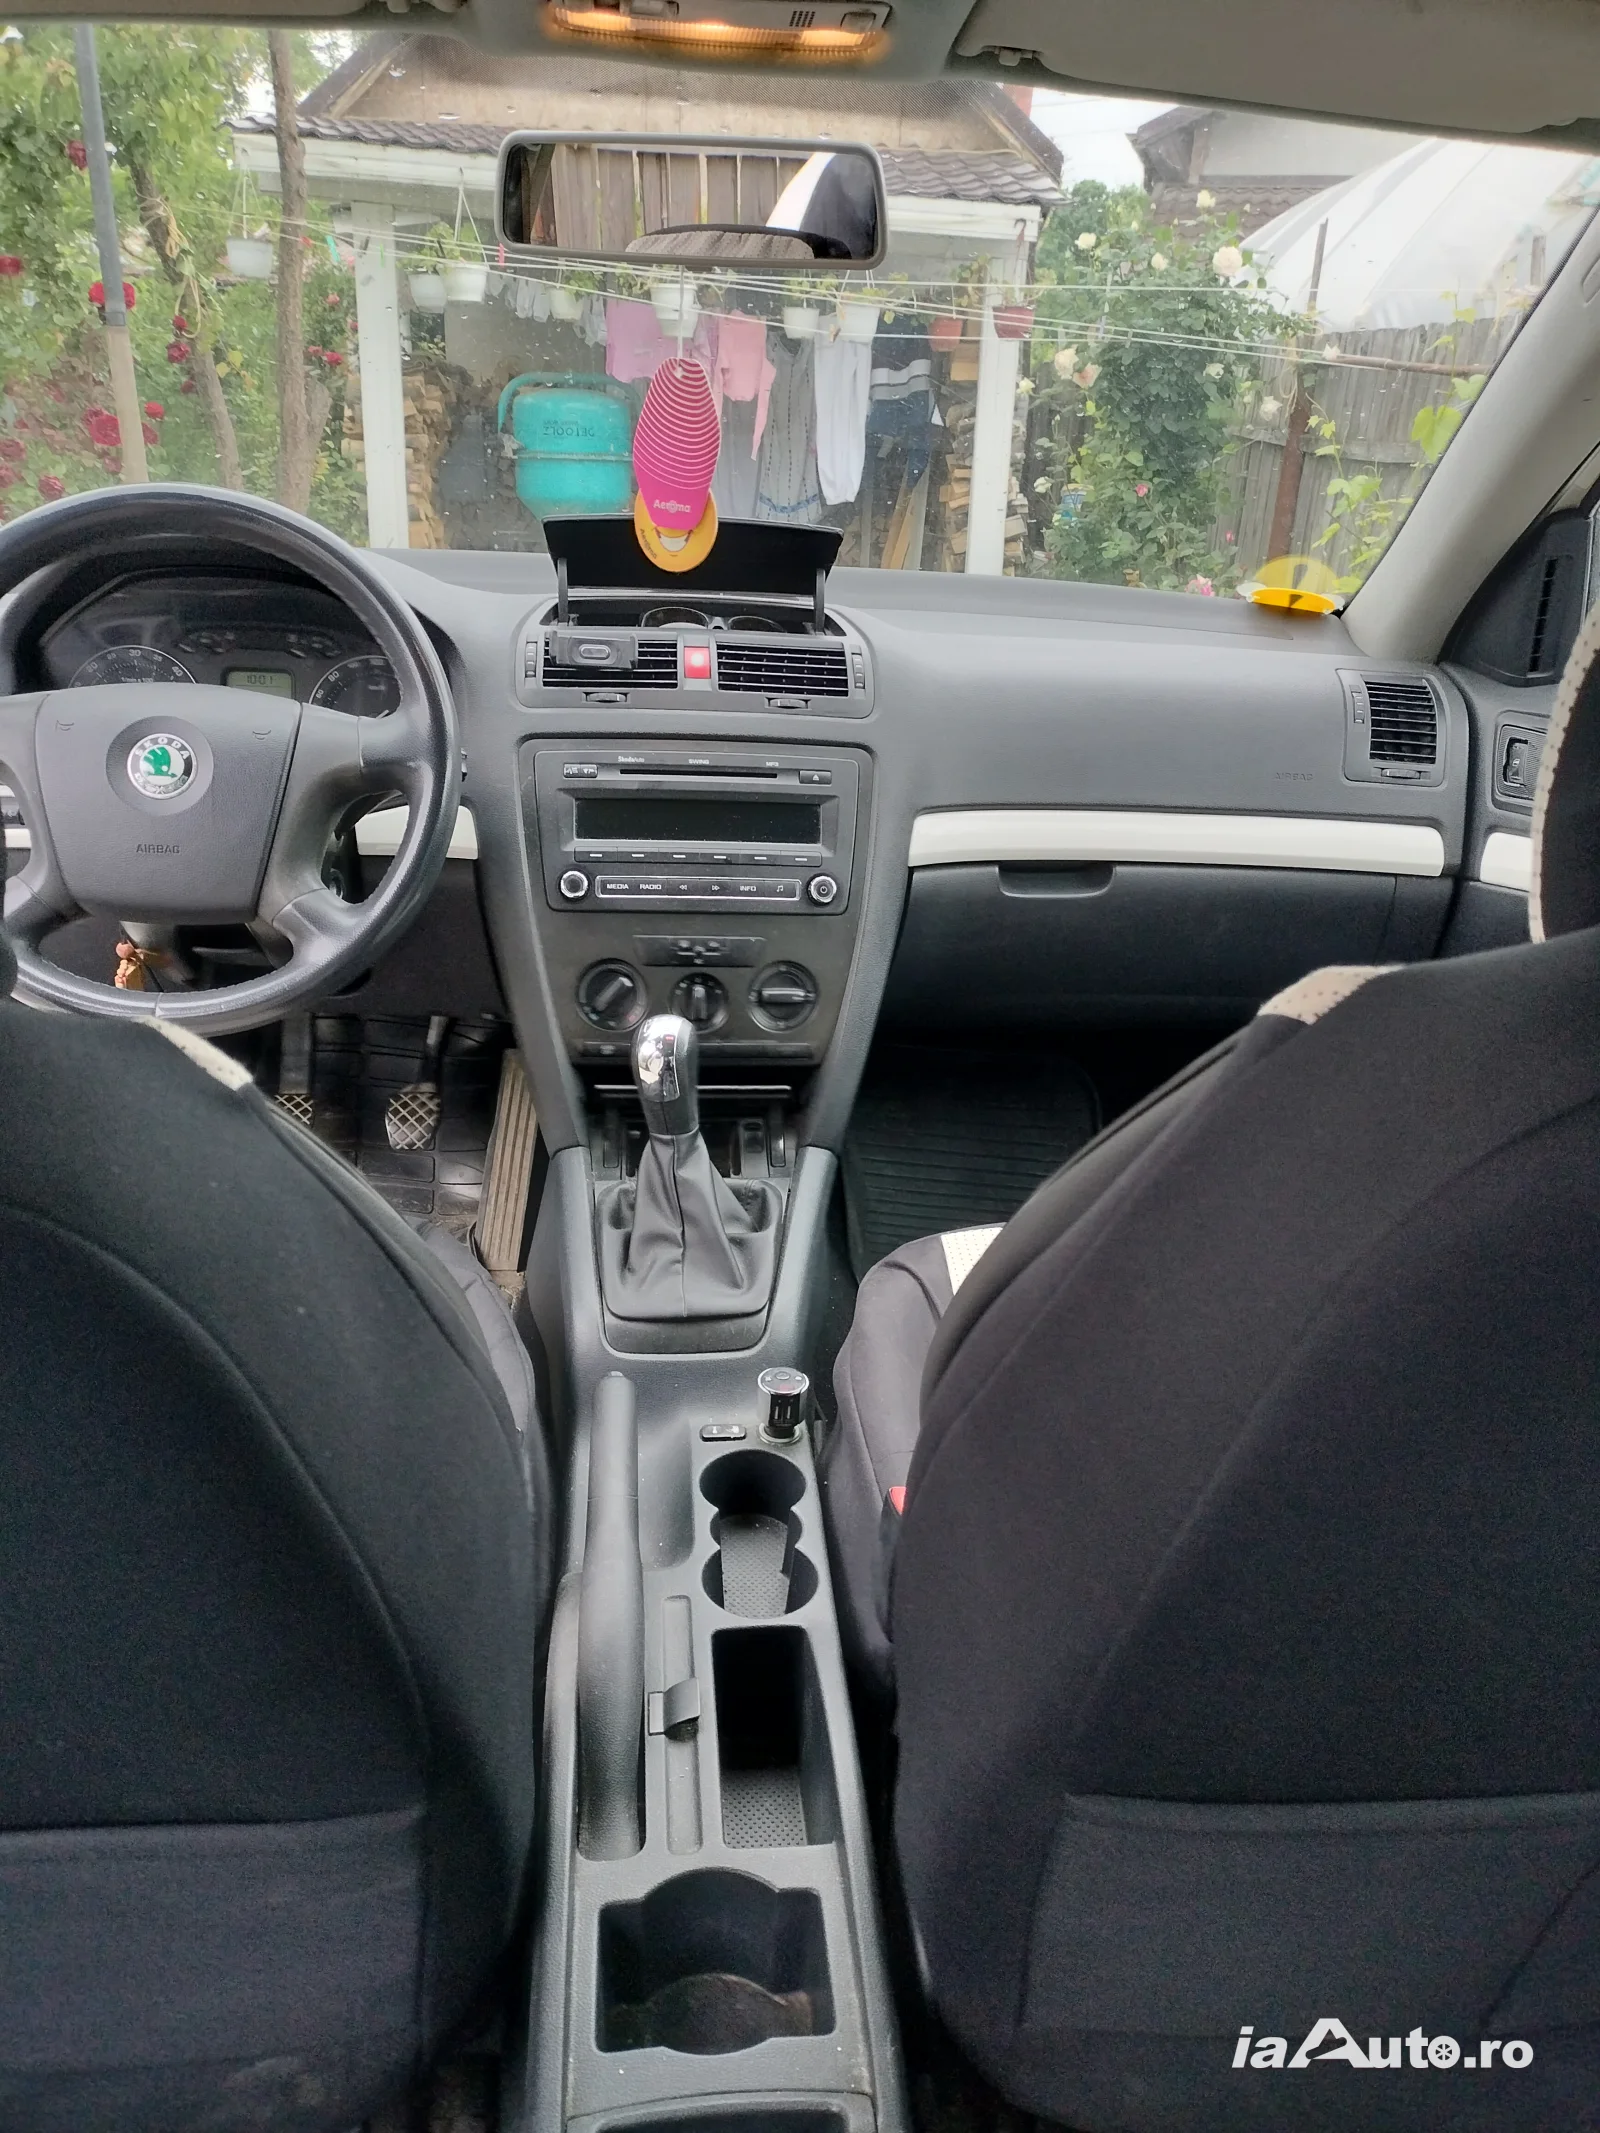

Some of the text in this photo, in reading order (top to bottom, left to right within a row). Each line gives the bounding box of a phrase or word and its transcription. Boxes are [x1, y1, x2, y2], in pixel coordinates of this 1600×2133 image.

[653, 500, 691, 513] Aeroma
[129, 649, 141, 657] 30
[135, 843, 180, 854] AIRBAG
